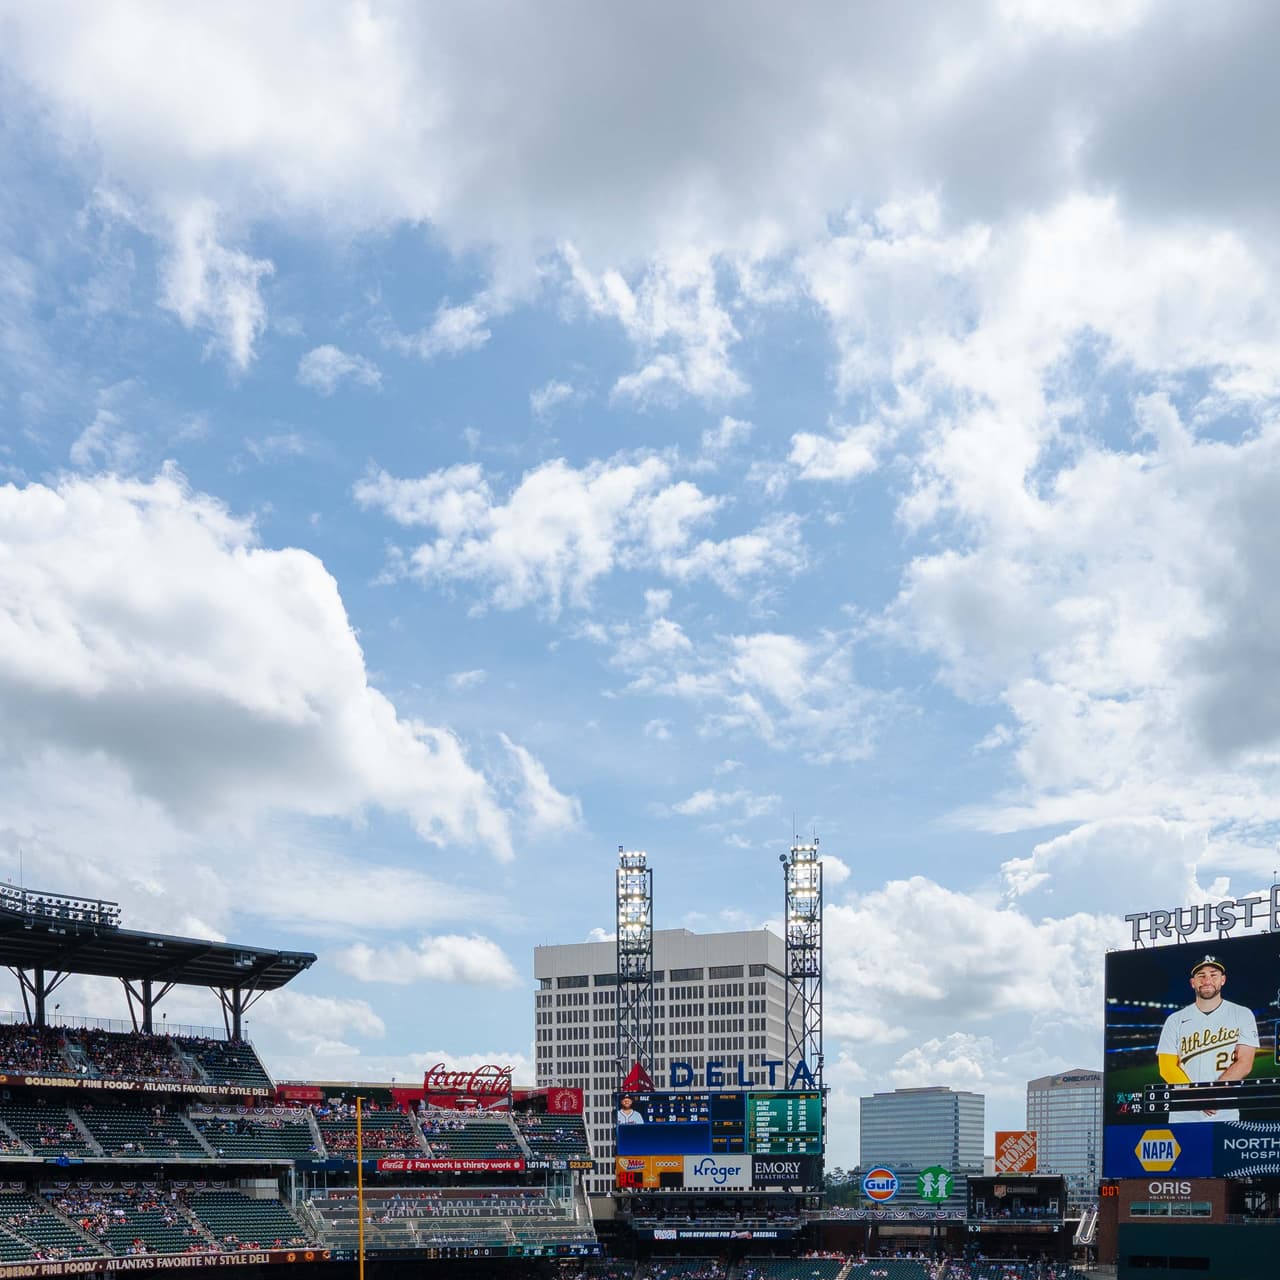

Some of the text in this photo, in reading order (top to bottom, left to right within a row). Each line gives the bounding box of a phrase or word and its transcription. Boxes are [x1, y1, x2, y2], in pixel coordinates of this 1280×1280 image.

[1126, 897, 1262, 941] TRUIST
[1180, 1027, 1241, 1057] Athletics
[670, 1060, 816, 1087] DELTA
[996, 1132, 1037, 1170] HOME
[1001, 1136, 1016, 1150] THE
[1143, 1141, 1173, 1159] NAPA
[462, 1162, 489, 1170] thirsty
[694, 1158, 741, 1184] Kroger
[756, 1162, 800, 1173] EMORY
[1012, 1150, 1037, 1172] DEPOT
[865, 1179, 895, 1190] Gulf
[1148, 1182, 1191, 1195] ORIS
